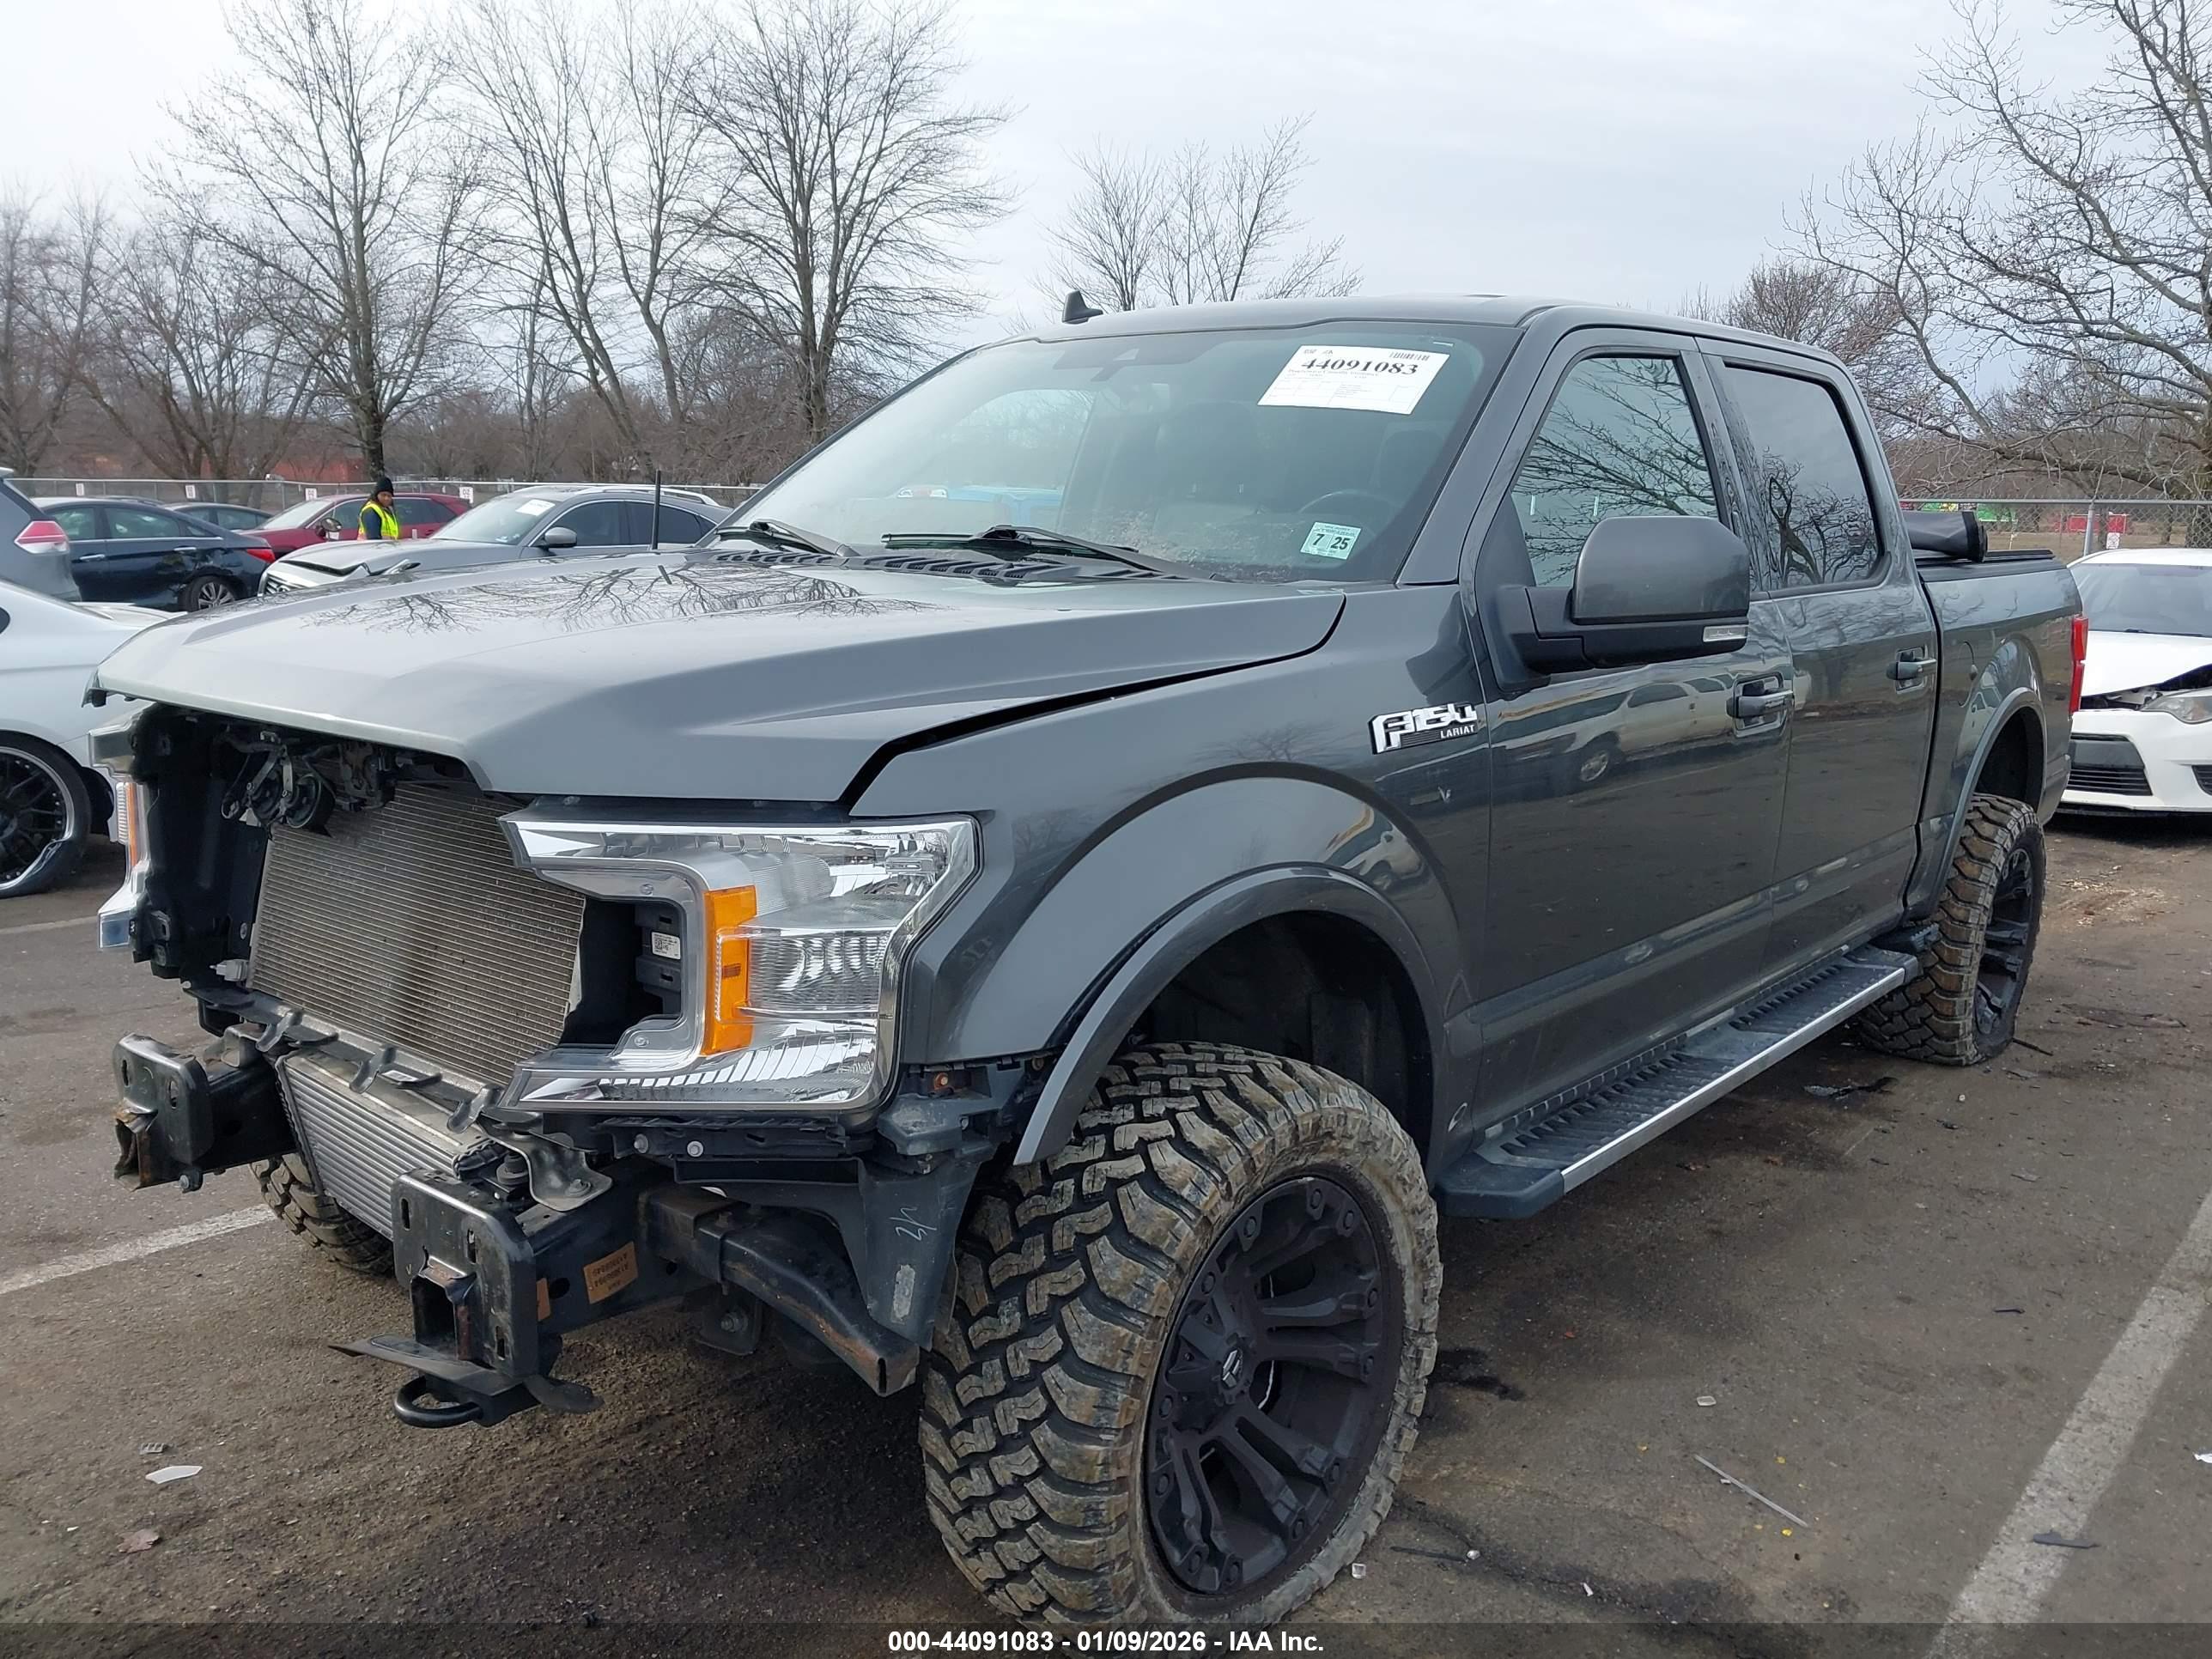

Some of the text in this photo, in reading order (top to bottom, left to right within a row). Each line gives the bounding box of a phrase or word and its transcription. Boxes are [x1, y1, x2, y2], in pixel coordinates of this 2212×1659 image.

[1300, 358, 1418, 375] 44091083
[1312, 533, 1351, 550] 7 25
[1440, 725, 1474, 738] LARIAT
